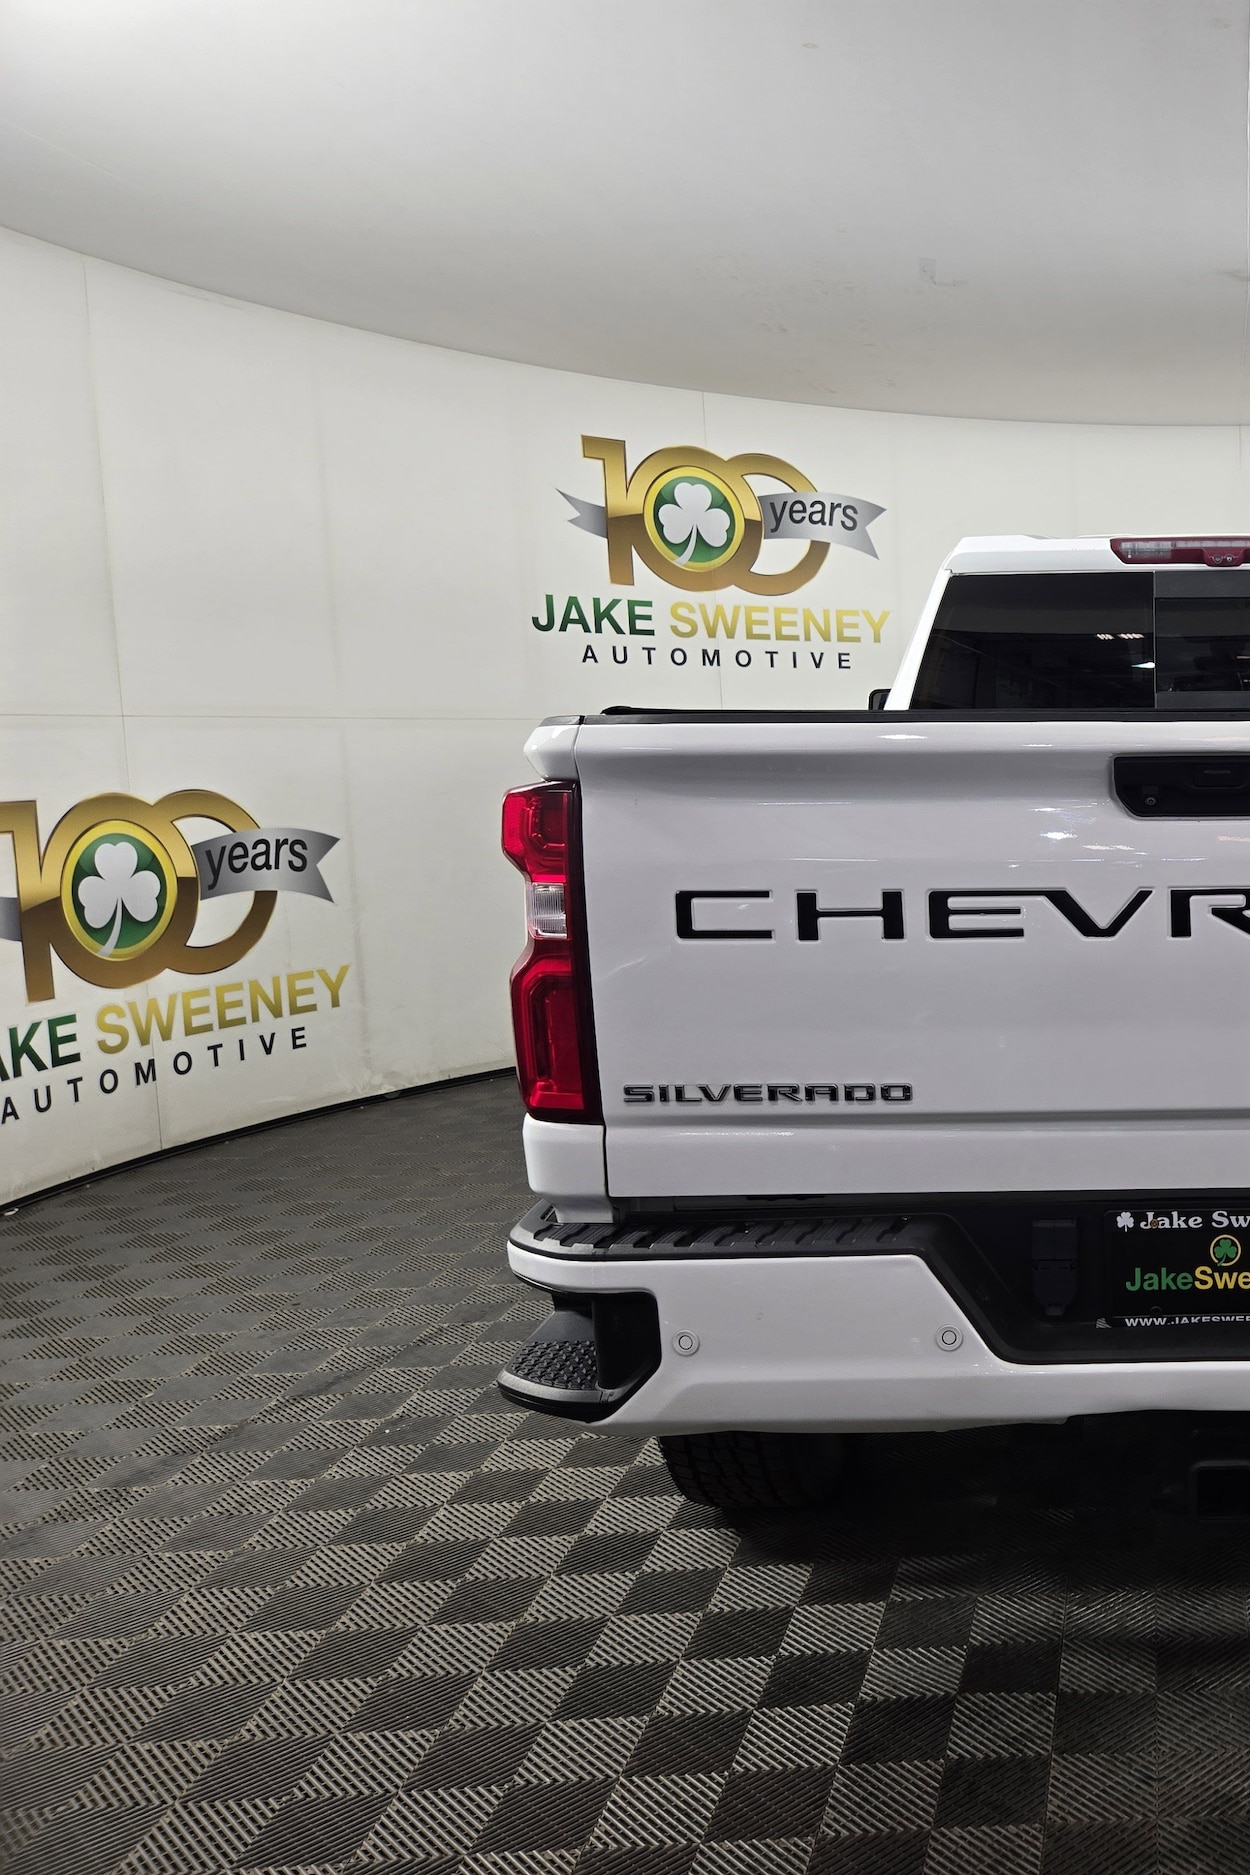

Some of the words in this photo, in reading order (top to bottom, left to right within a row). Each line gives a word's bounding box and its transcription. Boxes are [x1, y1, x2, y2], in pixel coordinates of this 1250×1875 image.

[580, 434, 831, 596] 100
[769, 497, 859, 533] years
[532, 594, 655, 636] JAKE
[669, 601, 891, 643] SWEENEY
[581, 644, 852, 669] AUTOMOTIVE
[0, 789, 278, 1004] 100
[205, 838, 308, 891] years
[95, 965, 350, 1055] SWEENEY
[1, 1027, 307, 1125] AUTOMOTIVE
[623, 1083, 913, 1102] SILVERADO
[1140, 1211, 1203, 1229] Jake
